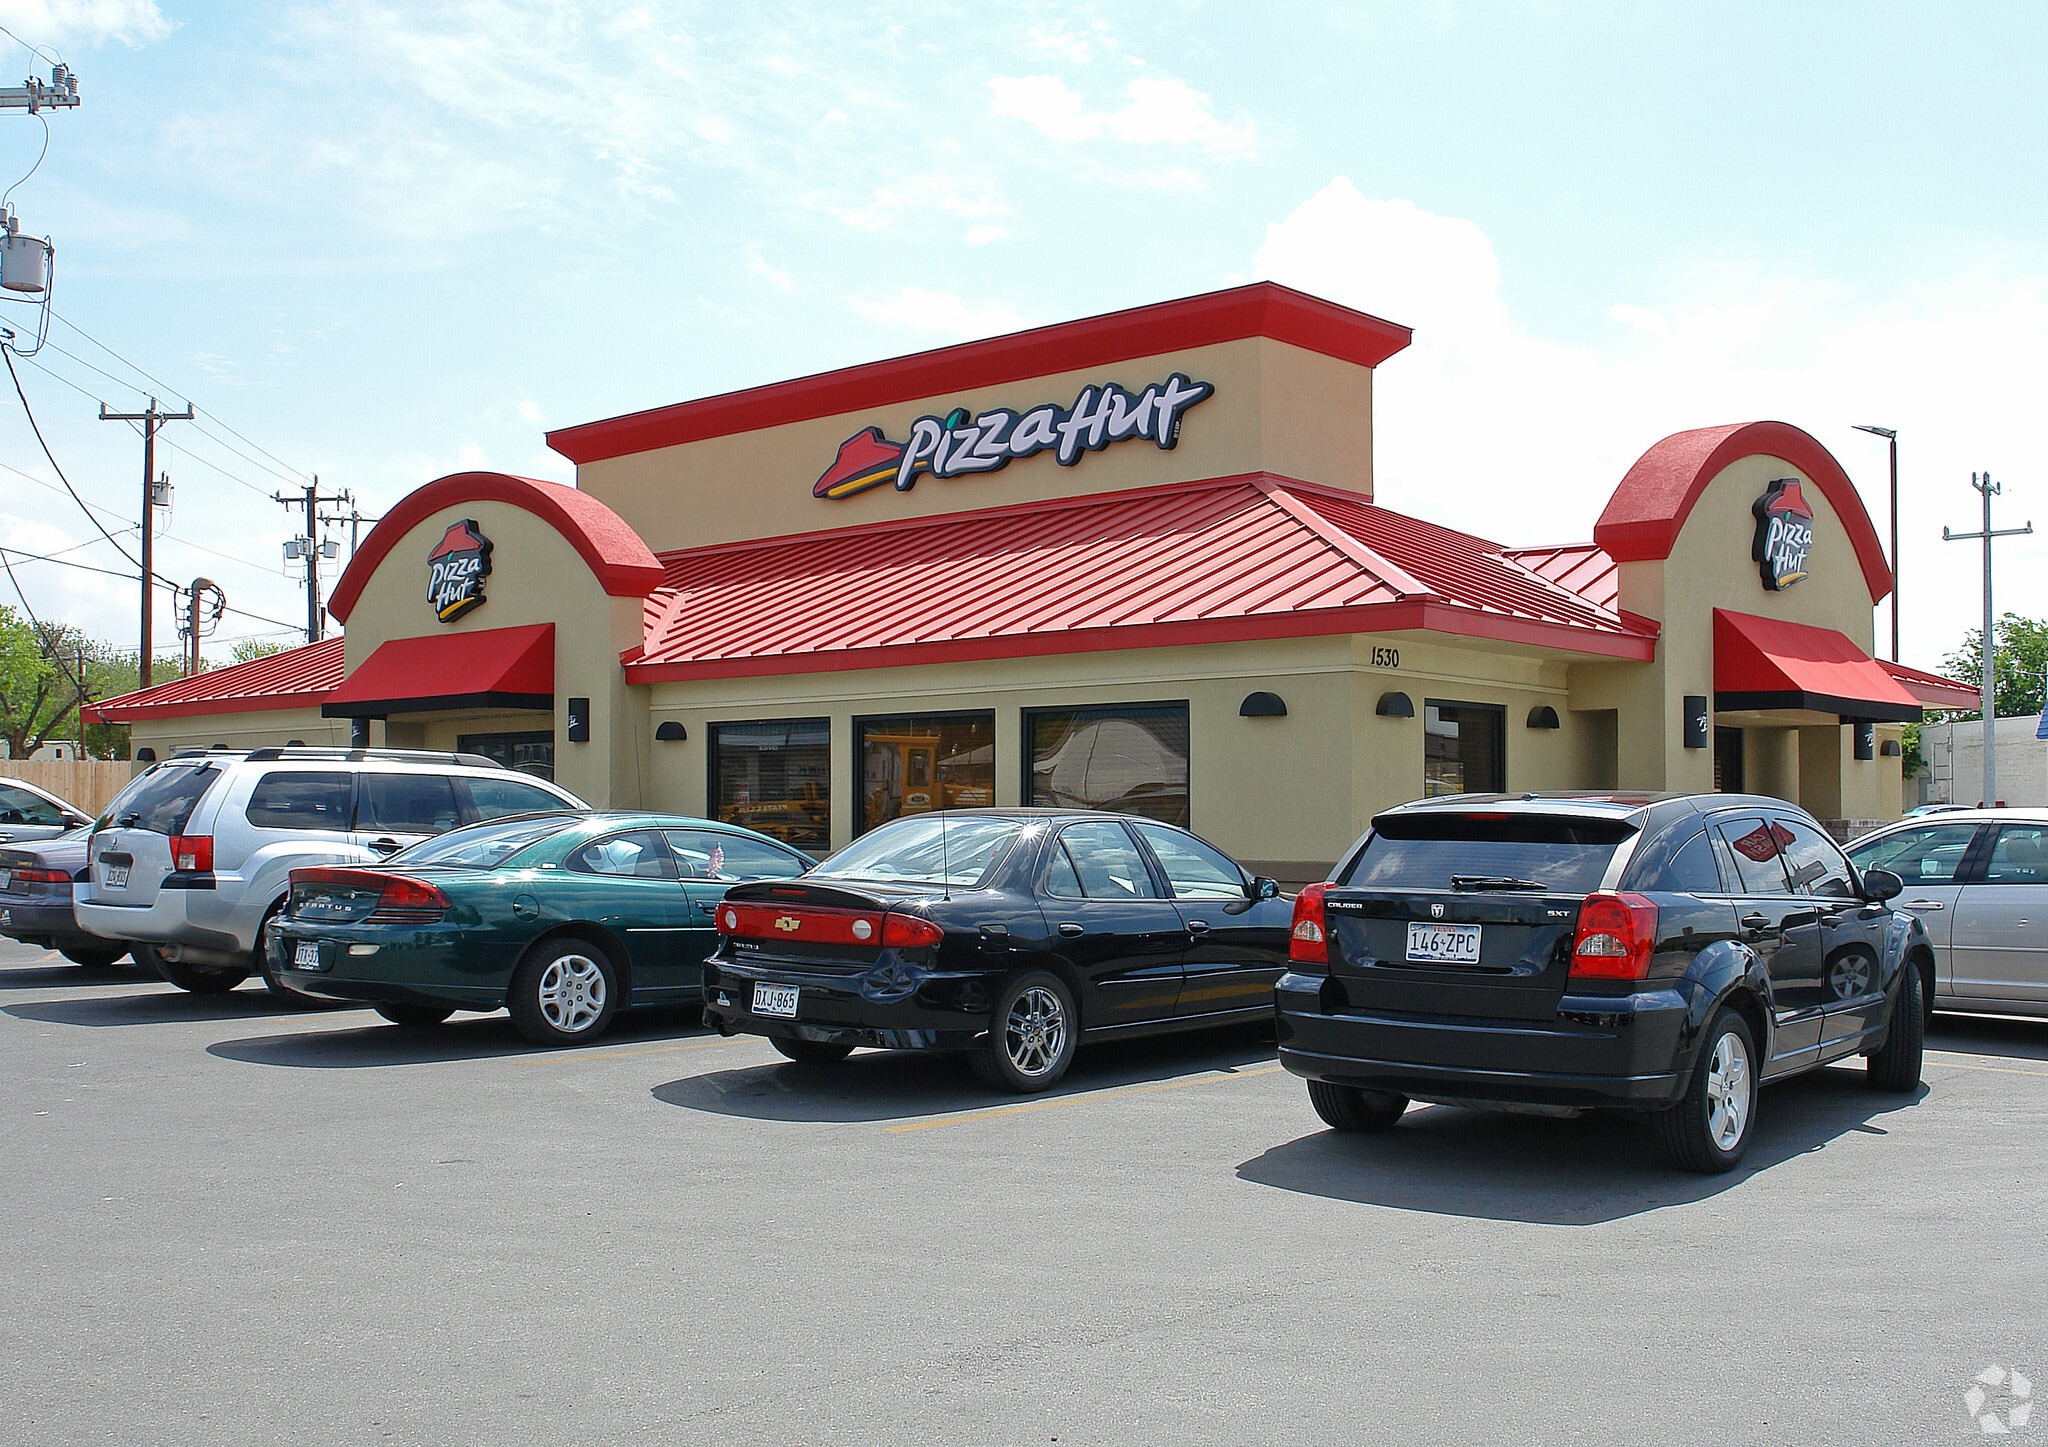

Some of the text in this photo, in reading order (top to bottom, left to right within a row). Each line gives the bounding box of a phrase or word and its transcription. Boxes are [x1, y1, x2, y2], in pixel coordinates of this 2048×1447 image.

[897, 377, 1204, 487] Pizza Hut
[1765, 511, 1813, 562] Pizza
[427, 552, 480, 601] Pizza
[1774, 543, 1807, 575] Hut
[435, 577, 475, 612] Hut
[1371, 646, 1400, 668] 1530
[298, 902, 353, 912] STRATUS
